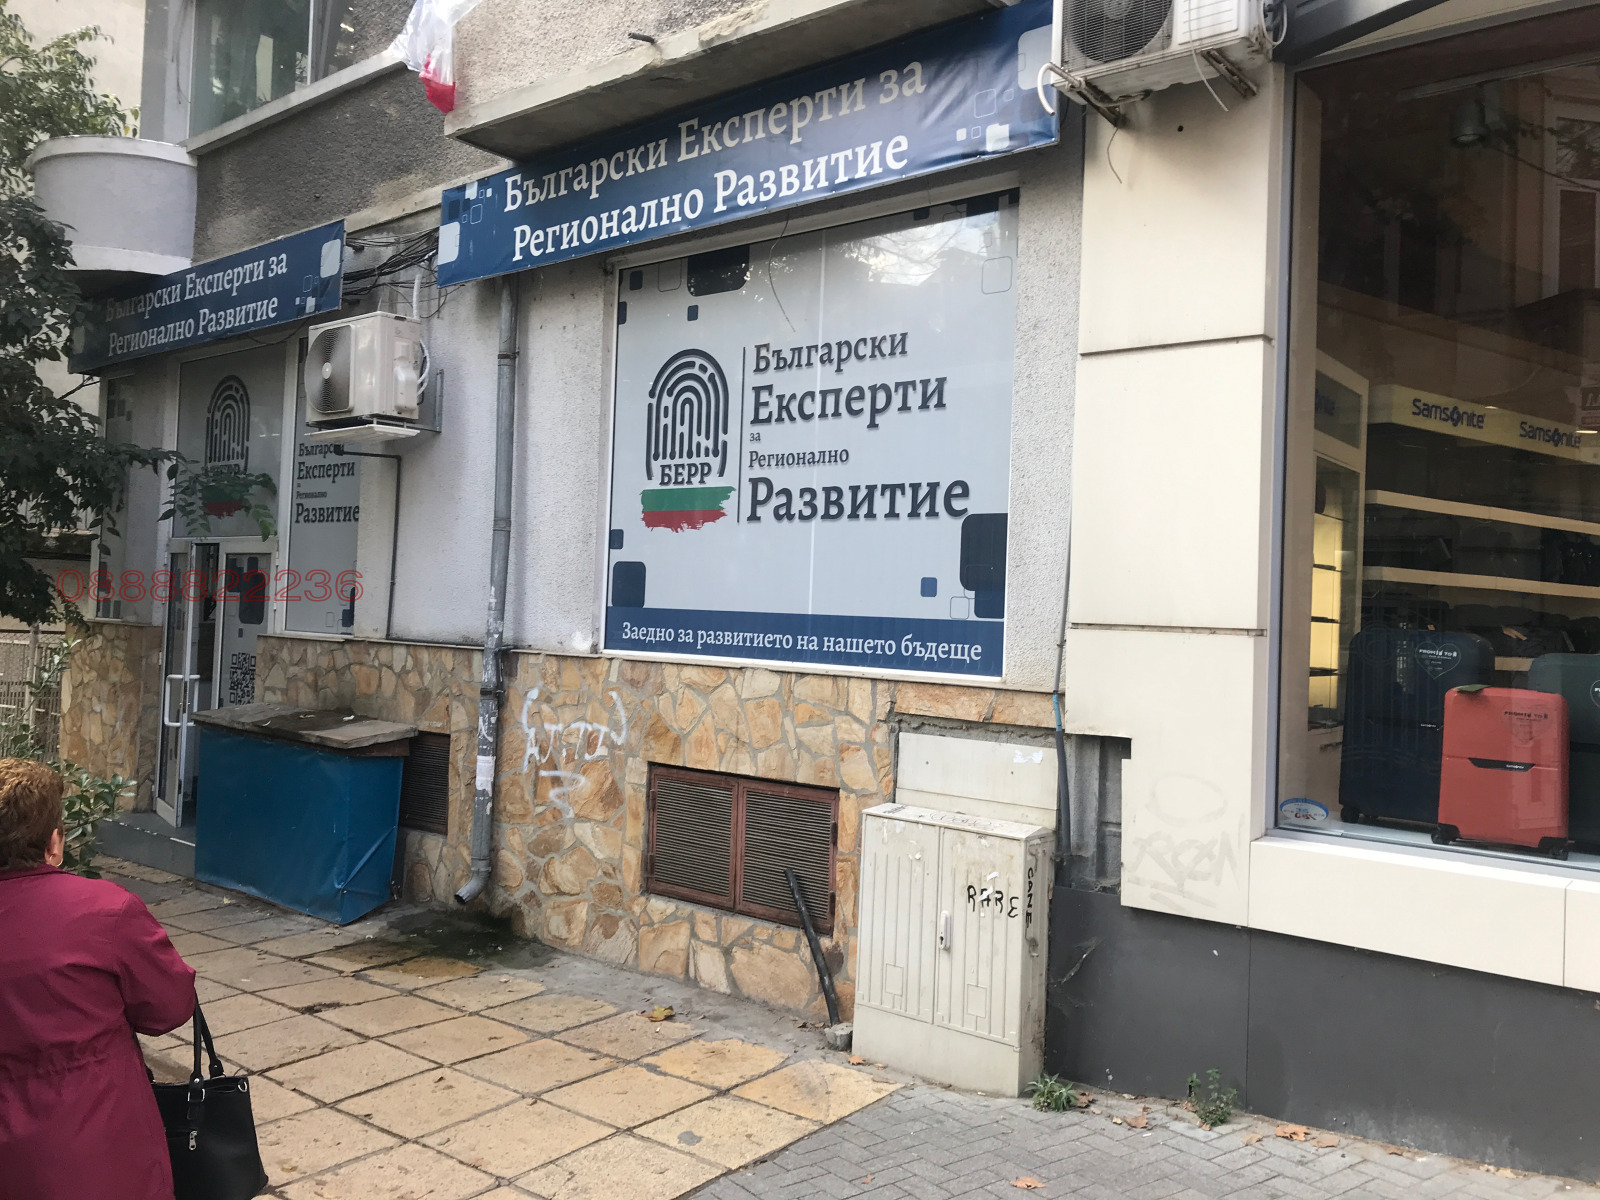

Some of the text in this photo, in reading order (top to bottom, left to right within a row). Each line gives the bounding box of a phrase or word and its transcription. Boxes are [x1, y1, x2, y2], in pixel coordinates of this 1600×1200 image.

[502, 61, 926, 213] Български Експерти за
[511, 134, 909, 262] Регионално Развитие
[105, 253, 288, 323] Български Експерти за
[108, 297, 278, 357] Регионално Развитие
[752, 331, 908, 374] Български
[749, 376, 948, 429] Експерти
[1412, 398, 1485, 429] Samsonite
[749, 431, 762, 443] за
[1519, 421, 1581, 448] Samsonite
[297, 461, 356, 484] Експерти
[659, 462, 713, 486] БЕРР
[748, 447, 849, 469] Регионално
[295, 502, 360, 524] Развитие
[746, 477, 970, 523] Развитие
[622, 621, 982, 662] Заедно за развитието на нашето бъдеще
